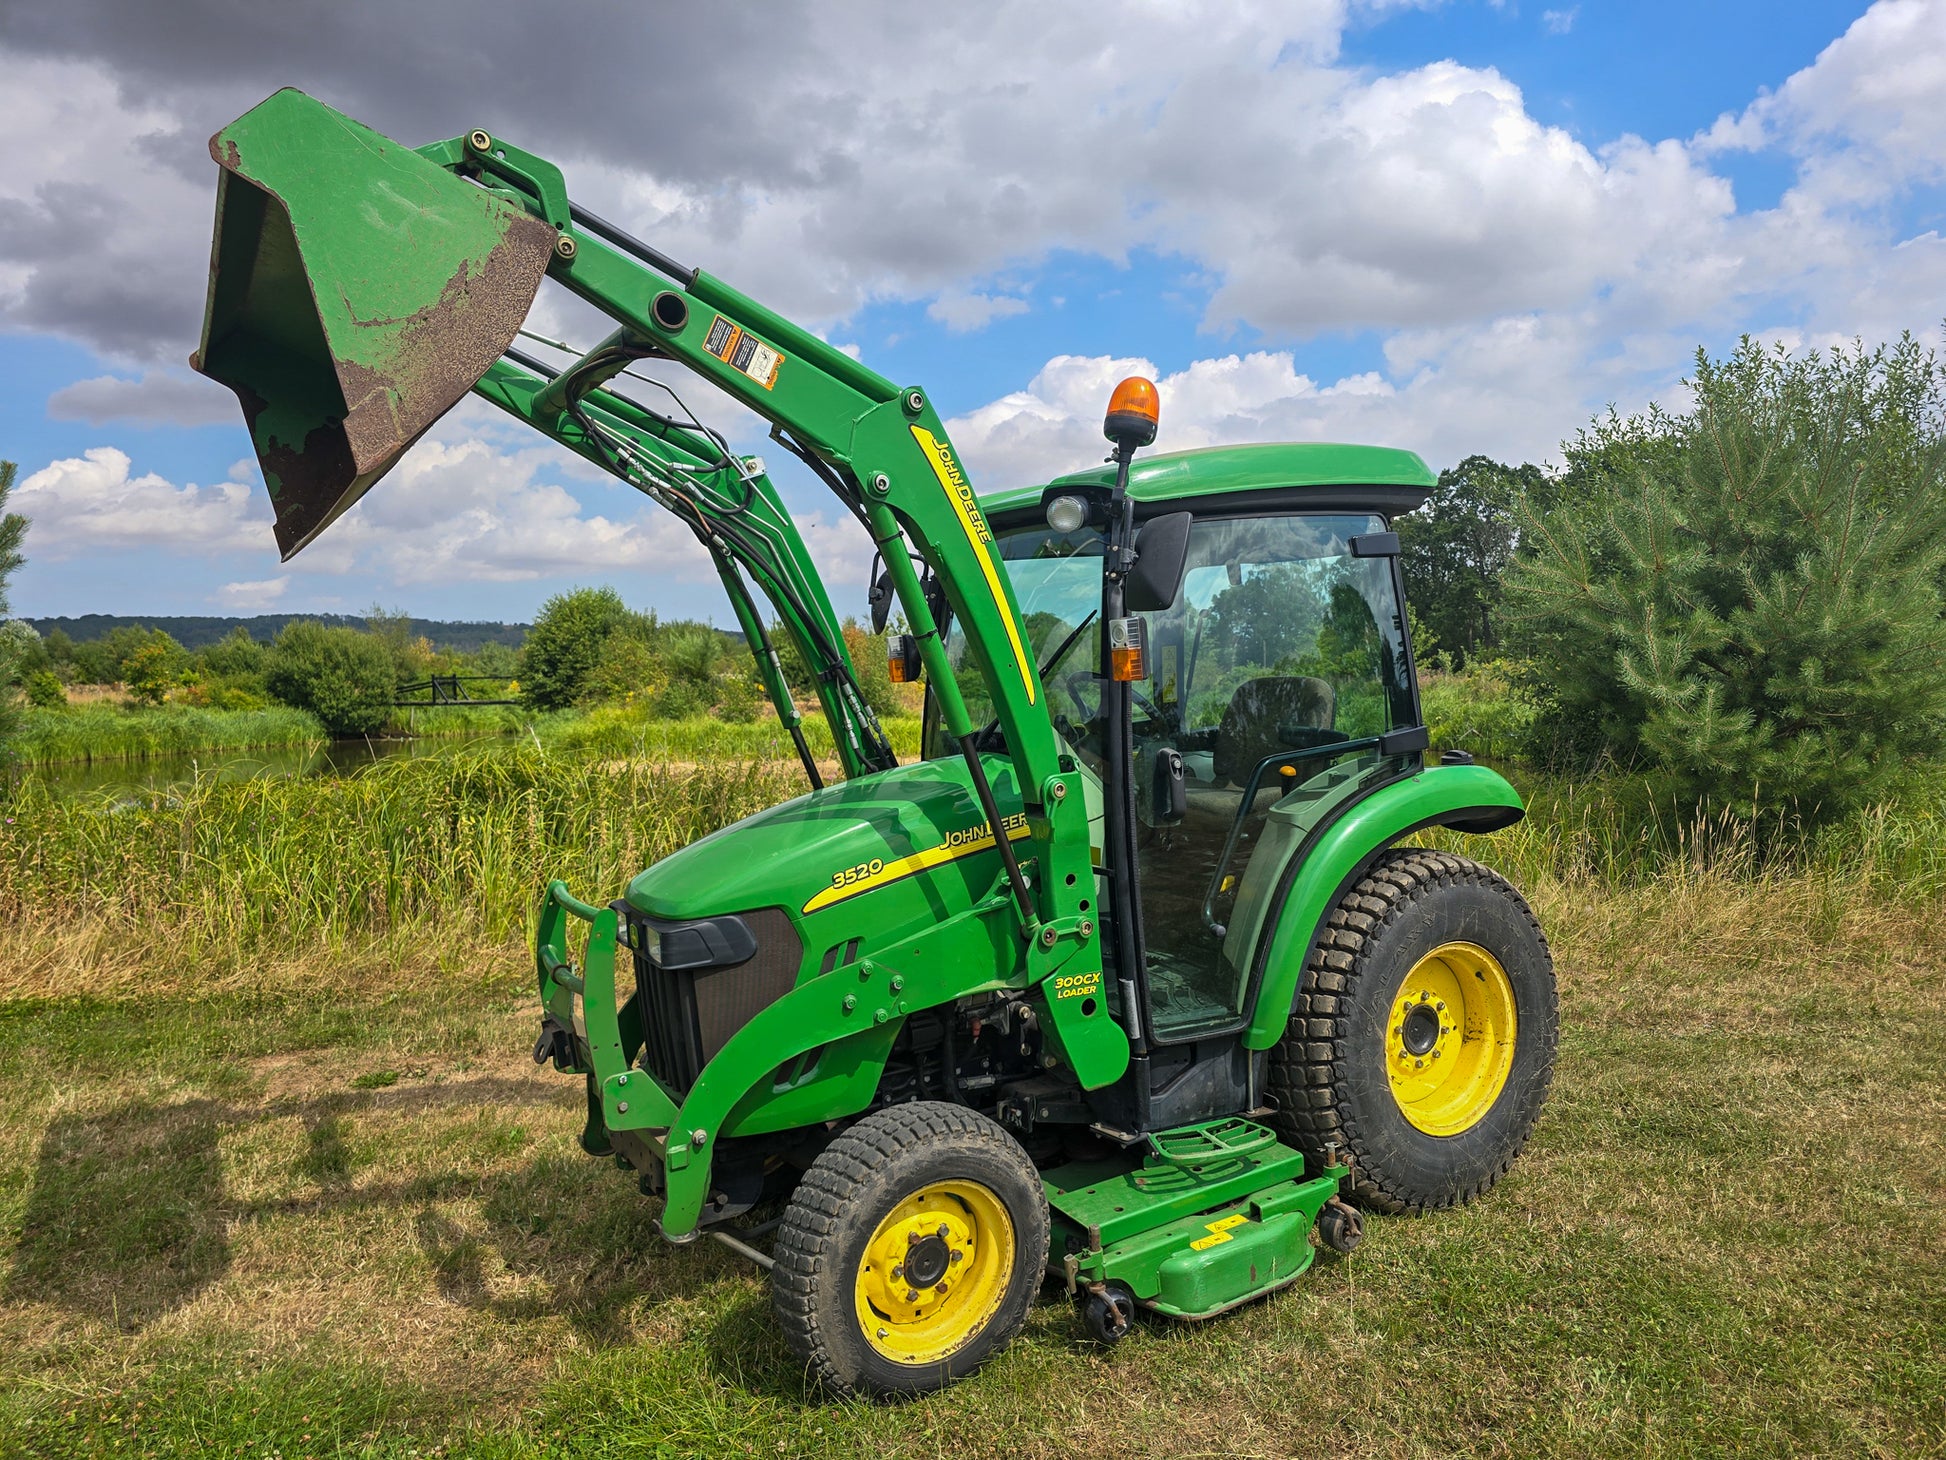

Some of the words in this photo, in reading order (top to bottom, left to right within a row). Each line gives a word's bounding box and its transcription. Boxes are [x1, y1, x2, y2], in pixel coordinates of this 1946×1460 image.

[932, 438, 964, 487] JOHN
[955, 484, 991, 545] DEERE
[940, 824, 984, 850] JOHN
[832, 858, 883, 889] 3520
[1055, 972, 1101, 989] 300CX
[1057, 985, 1097, 999] LOADER
